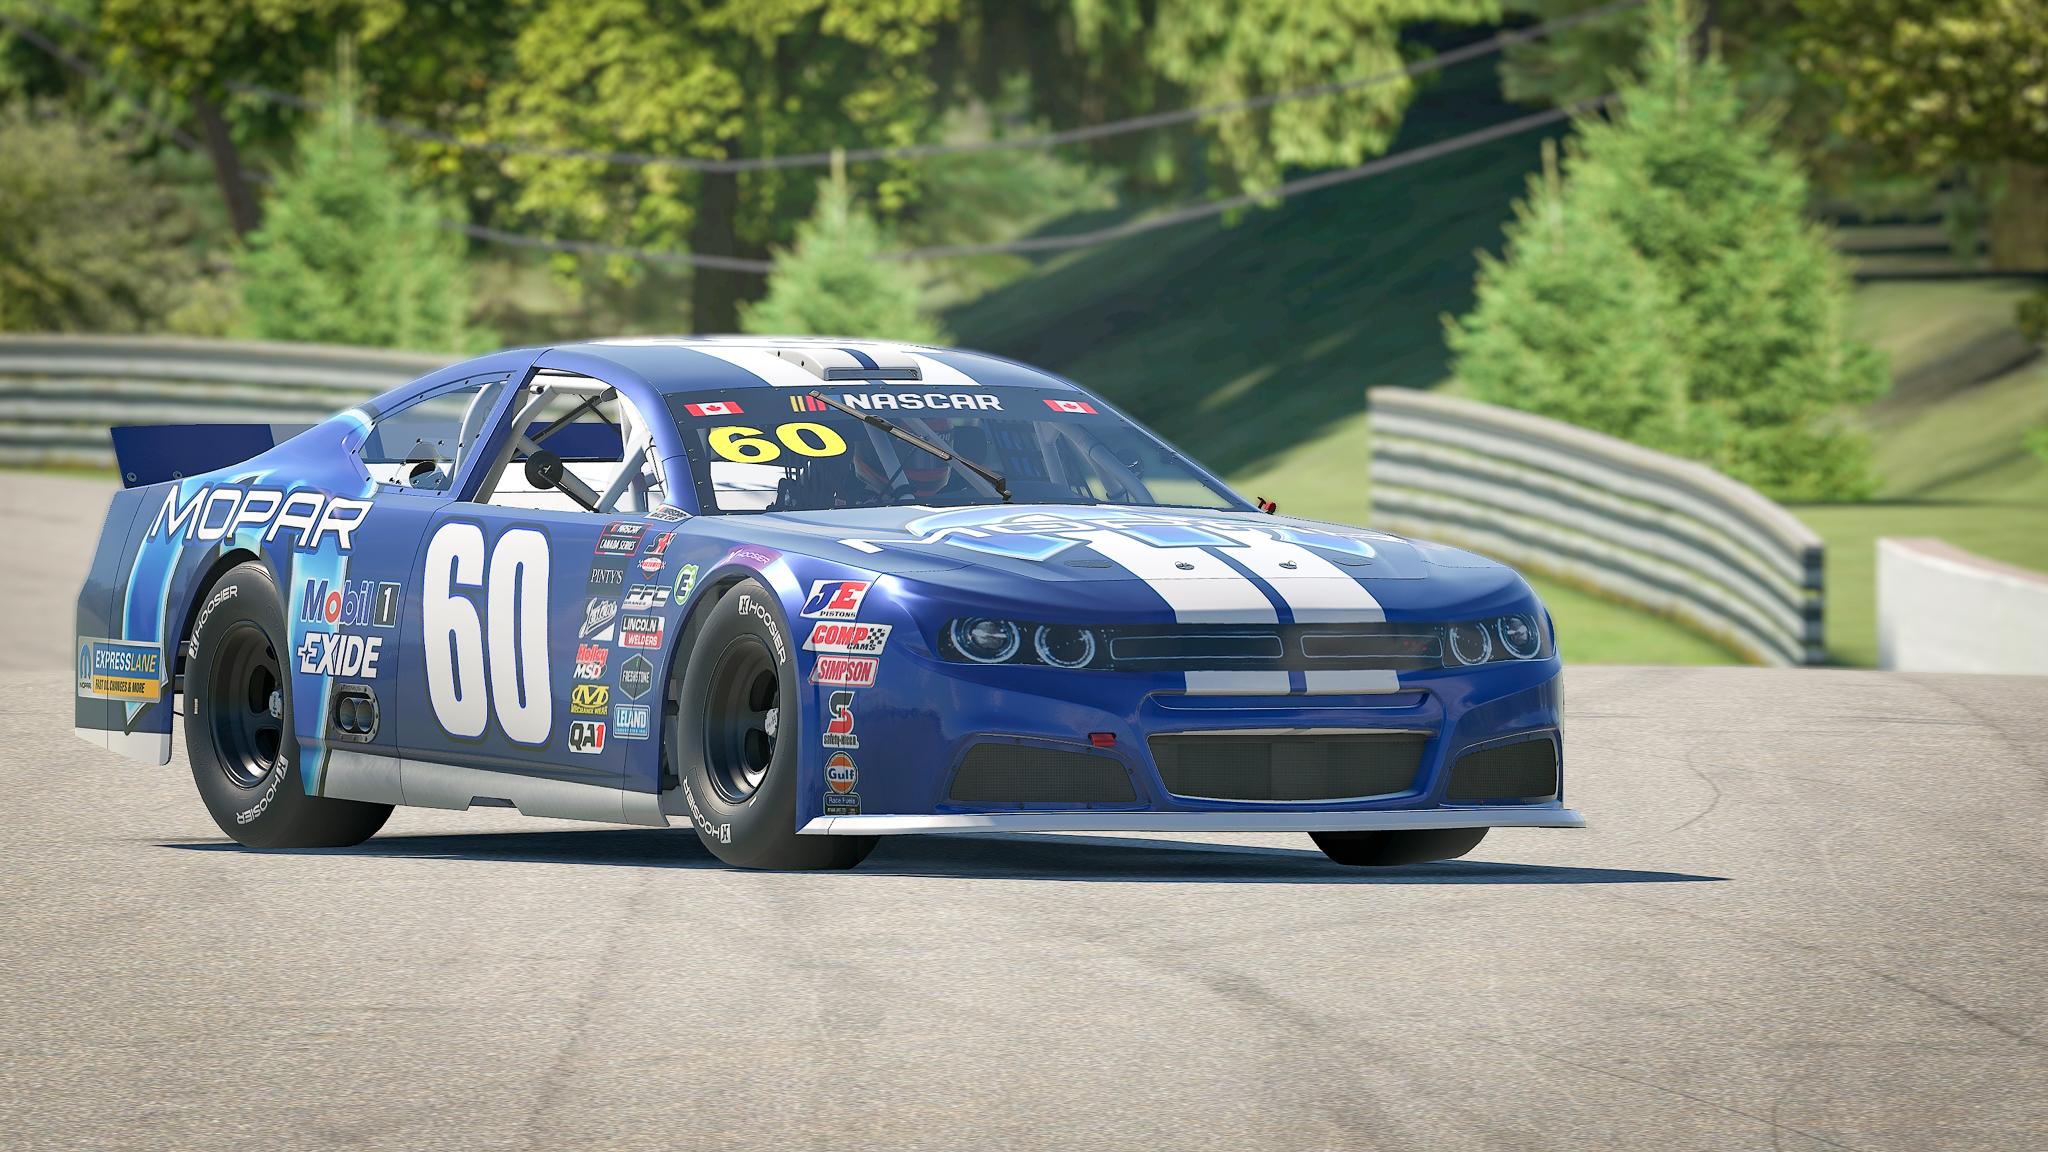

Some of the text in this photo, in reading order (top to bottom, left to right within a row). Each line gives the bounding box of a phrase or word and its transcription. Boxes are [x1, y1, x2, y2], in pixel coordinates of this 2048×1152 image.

[843, 393, 1004, 411] NASCAR
[708, 422, 848, 463] 60
[152, 485, 374, 549] MOPAR
[590, 568, 623, 584] PINTY'S
[195, 585, 238, 639] HOOSIER
[300, 578, 392, 626] Mobil 1
[803, 582, 867, 614] JE
[423, 522, 552, 745] 60
[622, 618, 657, 633] LINCOLN
[628, 633, 658, 646] WELDERS
[748, 601, 786, 666] HOOSIER
[811, 625, 868, 645] COMP
[298, 632, 383, 678] EXIDE
[847, 643, 876, 651] CAMS
[573, 663, 602, 680] MSD
[817, 660, 872, 682] SIMPSON
[617, 709, 647, 729] LELAND
[569, 722, 605, 750] QA1
[828, 768, 855, 780] Gulf
[236, 774, 281, 825] HOOSIER
[683, 776, 720, 839] HOOSIER
